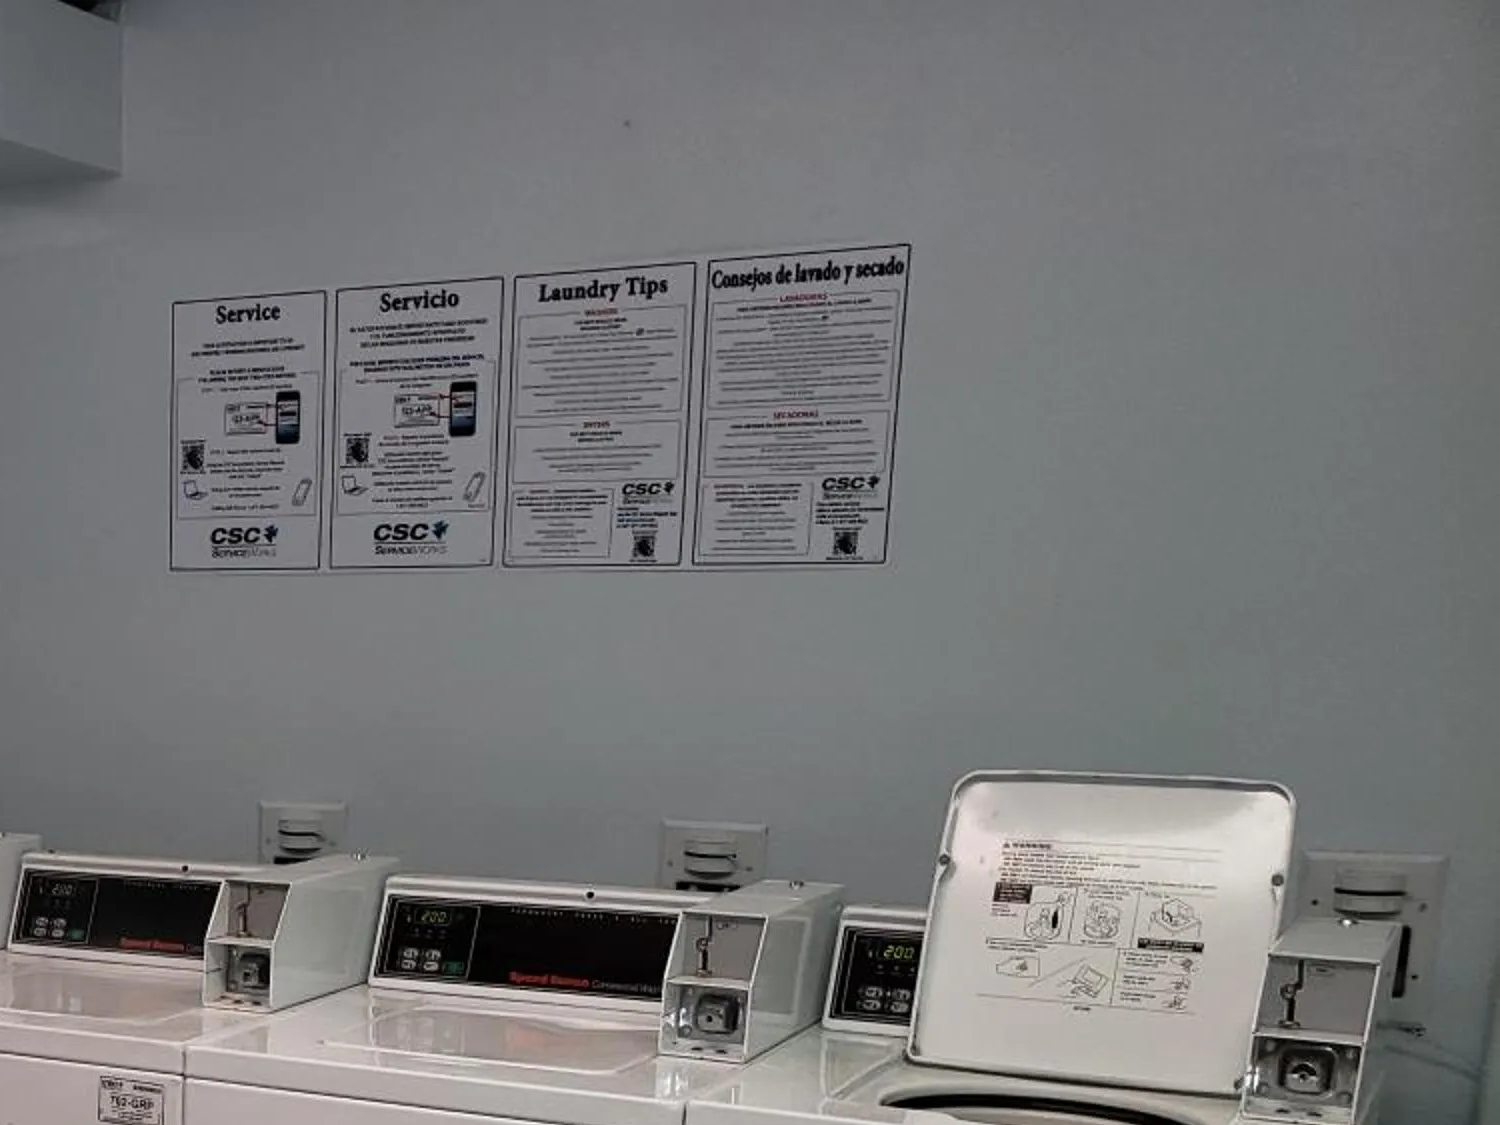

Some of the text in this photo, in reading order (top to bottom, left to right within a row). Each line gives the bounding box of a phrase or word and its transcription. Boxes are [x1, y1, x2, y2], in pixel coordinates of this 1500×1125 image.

[711, 256, 905, 292] Consejos de lavado y secado
[538, 276, 669, 303] Laundry Tips
[379, 289, 460, 313] Servicio
[215, 303, 282, 325] Service
[622, 483, 662, 495] CSC
[821, 477, 866, 491] CSC
[210, 527, 261, 544] CSC
[373, 523, 429, 541] CSC
[883, 944, 915, 960] 200
